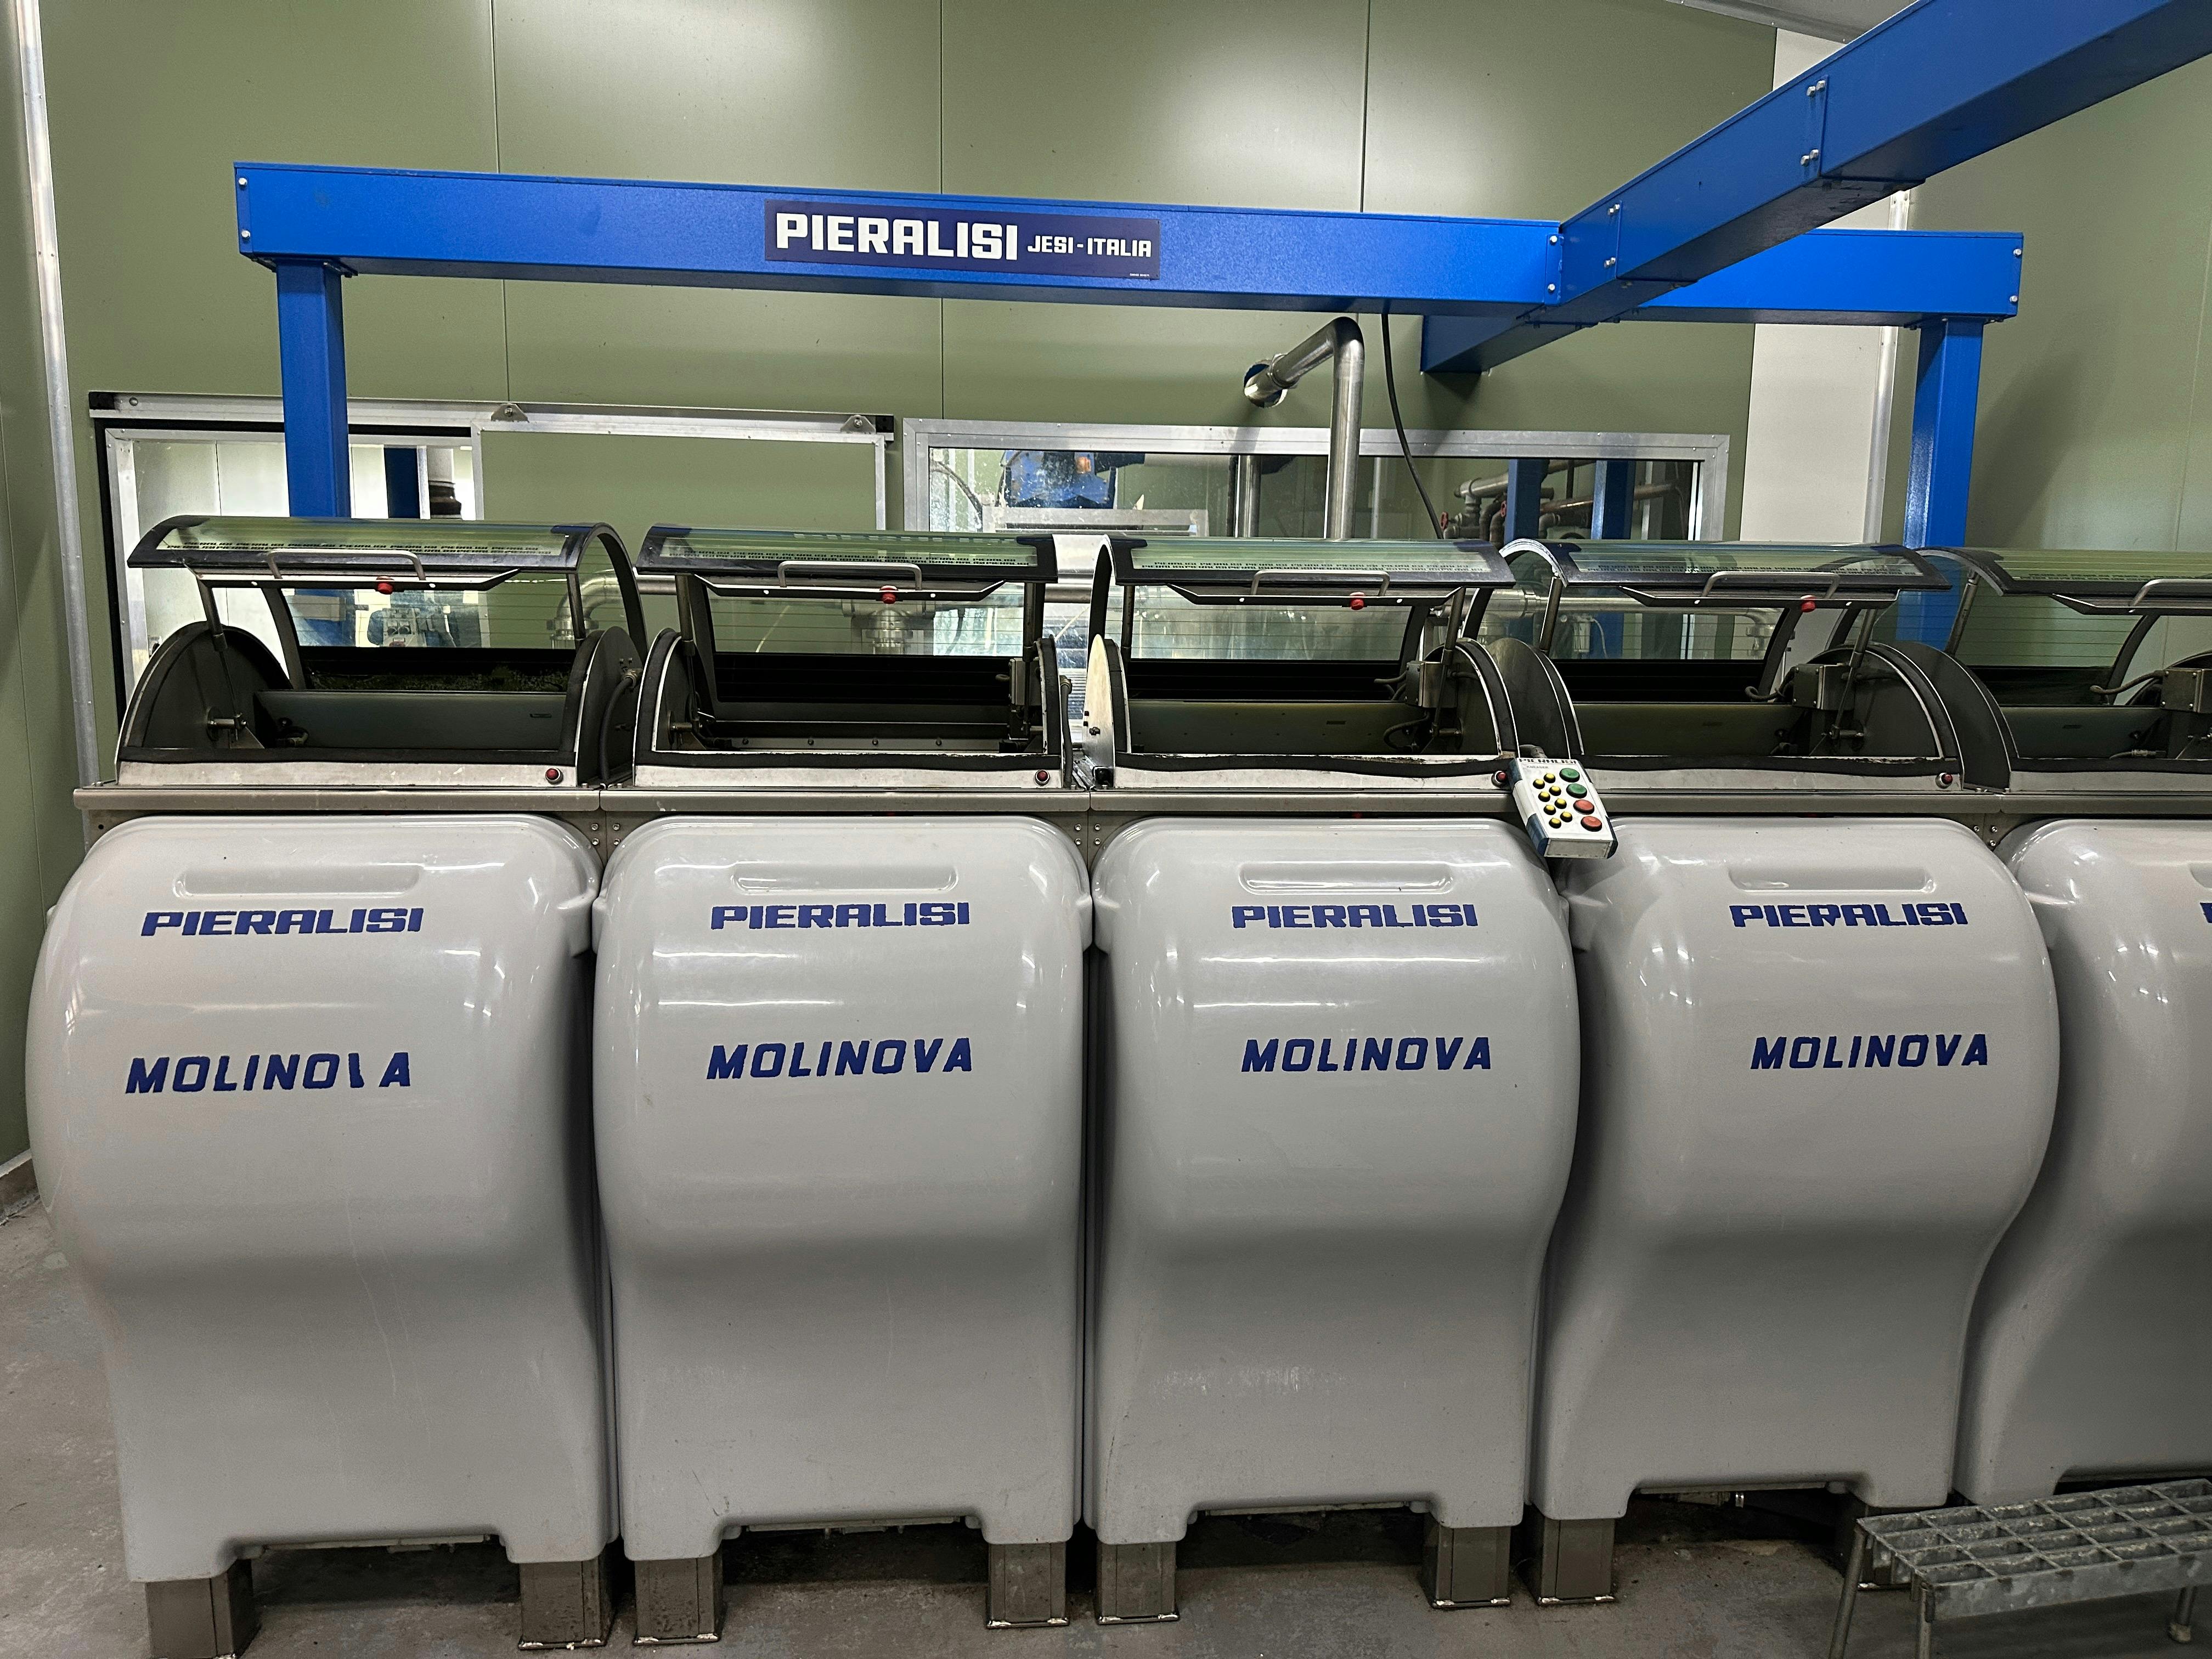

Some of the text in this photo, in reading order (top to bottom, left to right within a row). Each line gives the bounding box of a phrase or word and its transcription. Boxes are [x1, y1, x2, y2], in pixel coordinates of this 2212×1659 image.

[776, 212, 1018, 261] PIERALISI
[142, 908, 424, 936] PIERALISI
[710, 902, 970, 929] PIERALISI
[1231, 904, 1478, 928] PIERALISI
[1729, 903, 1967, 927] PIERALISI
[706, 1037, 972, 1080] MOLINOVA
[1241, 1037, 1491, 1072] MOLINOVA
[1750, 1034, 1988, 1069] MOLINOVA
